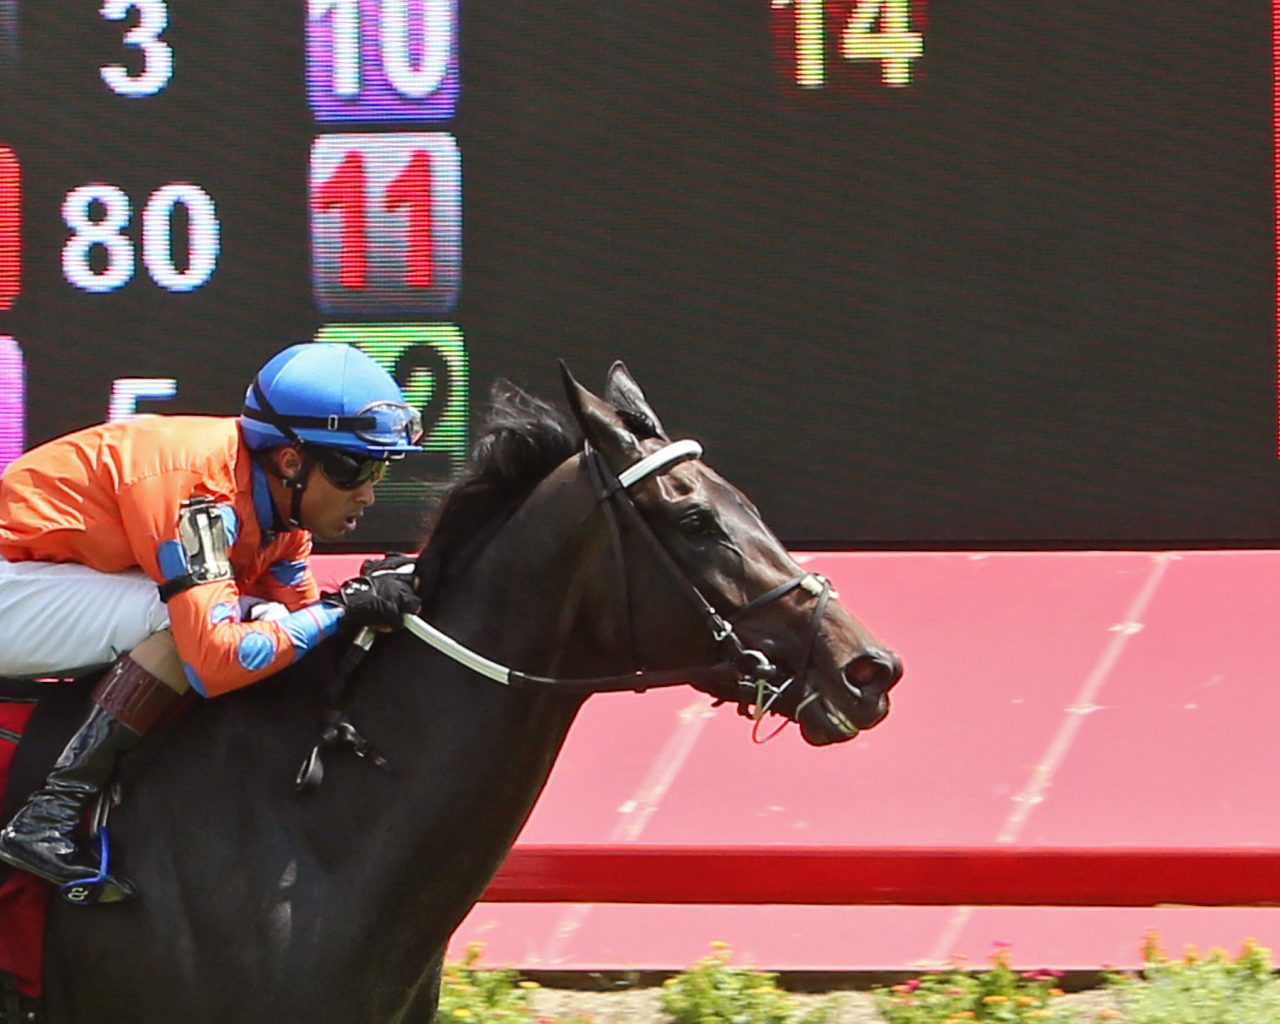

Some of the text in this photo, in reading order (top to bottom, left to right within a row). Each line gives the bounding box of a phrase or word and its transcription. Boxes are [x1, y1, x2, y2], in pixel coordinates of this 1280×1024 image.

[98, 0, 174, 98] 3
[307, 0, 452, 99] 10
[770, 0, 925, 87] 14
[60, 183, 220, 293] 80
[312, 150, 432, 288] 11
